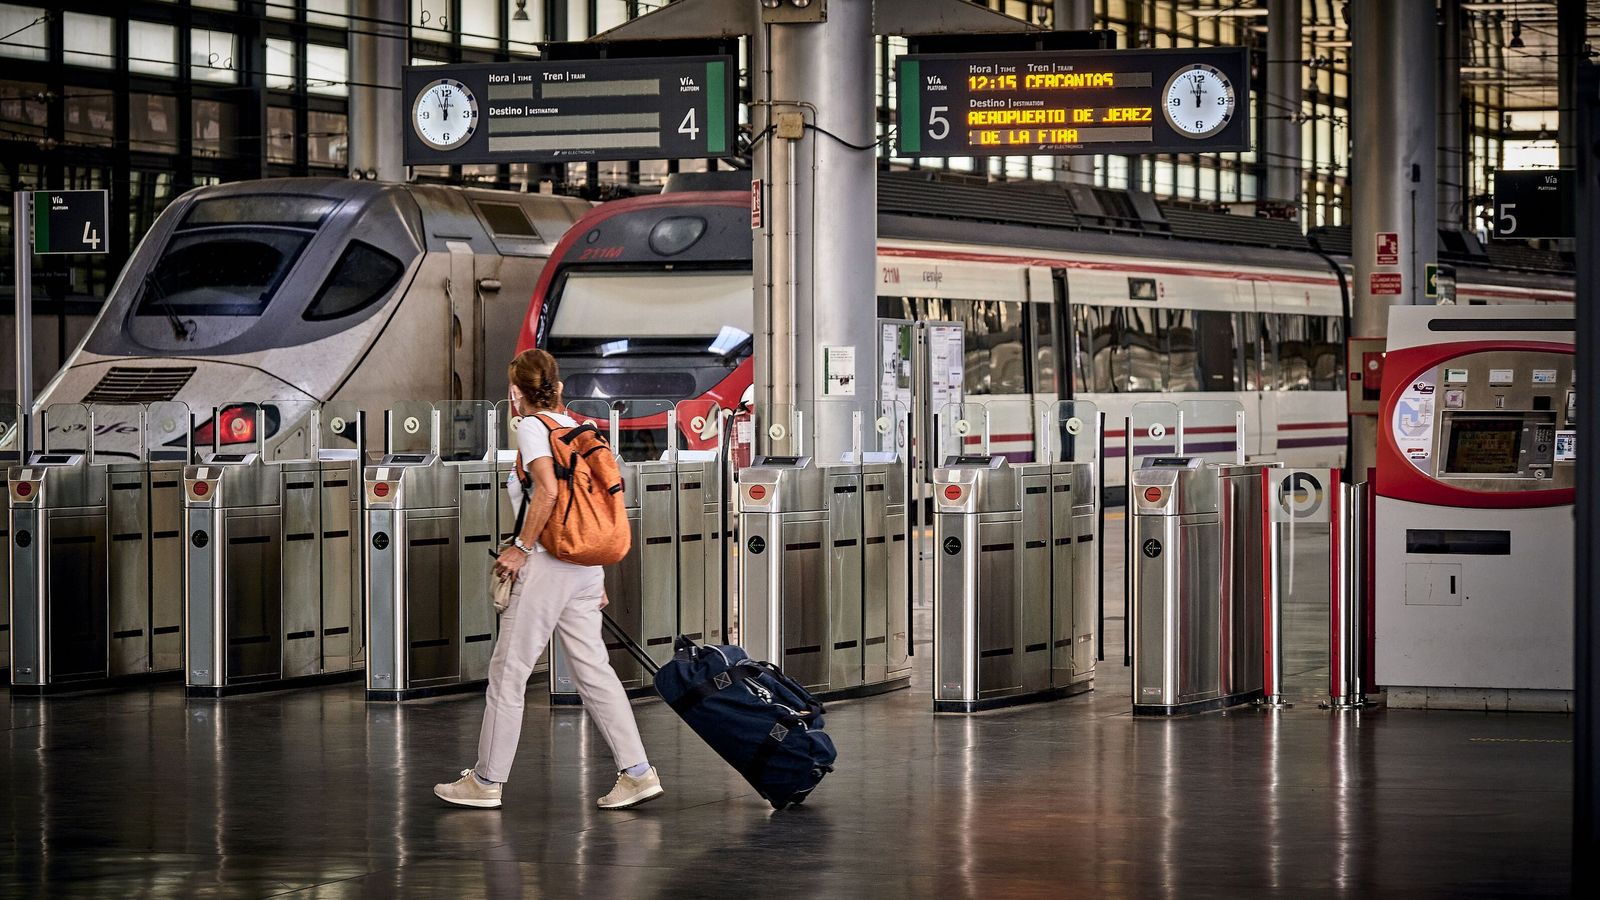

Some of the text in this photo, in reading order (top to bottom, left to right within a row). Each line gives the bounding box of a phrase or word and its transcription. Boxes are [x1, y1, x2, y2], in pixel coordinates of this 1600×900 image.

[969, 65, 992, 73] Hora
[1027, 63, 1049, 72] Tren
[489, 74, 510, 82] Hora
[543, 72, 563, 81] Tren
[1193, 75, 1205, 83] 12
[968, 75, 1017, 90] 12:15
[441, 89, 452, 98] 12
[970, 98, 1005, 107] Destino
[1173, 98, 1181, 106] 9
[1217, 97, 1225, 105] 3
[422, 111, 430, 119] 9
[462, 110, 470, 118] 3
[489, 107, 559, 116] Destino DESTINATION
[968, 107, 1152, 124] AEROPUERTO DE JEREZ
[677, 107, 700, 141] 4
[928, 106, 950, 140] 5
[1195, 120, 1203, 129] 6
[442, 133, 450, 141] 6
[980, 130, 1001, 144] DE
[1009, 130, 1030, 144] LA
[1544, 175, 1558, 184] Vía
[52, 196, 63, 204] Vía
[1500, 203, 1517, 234] 5
[82, 221, 101, 249] 4
